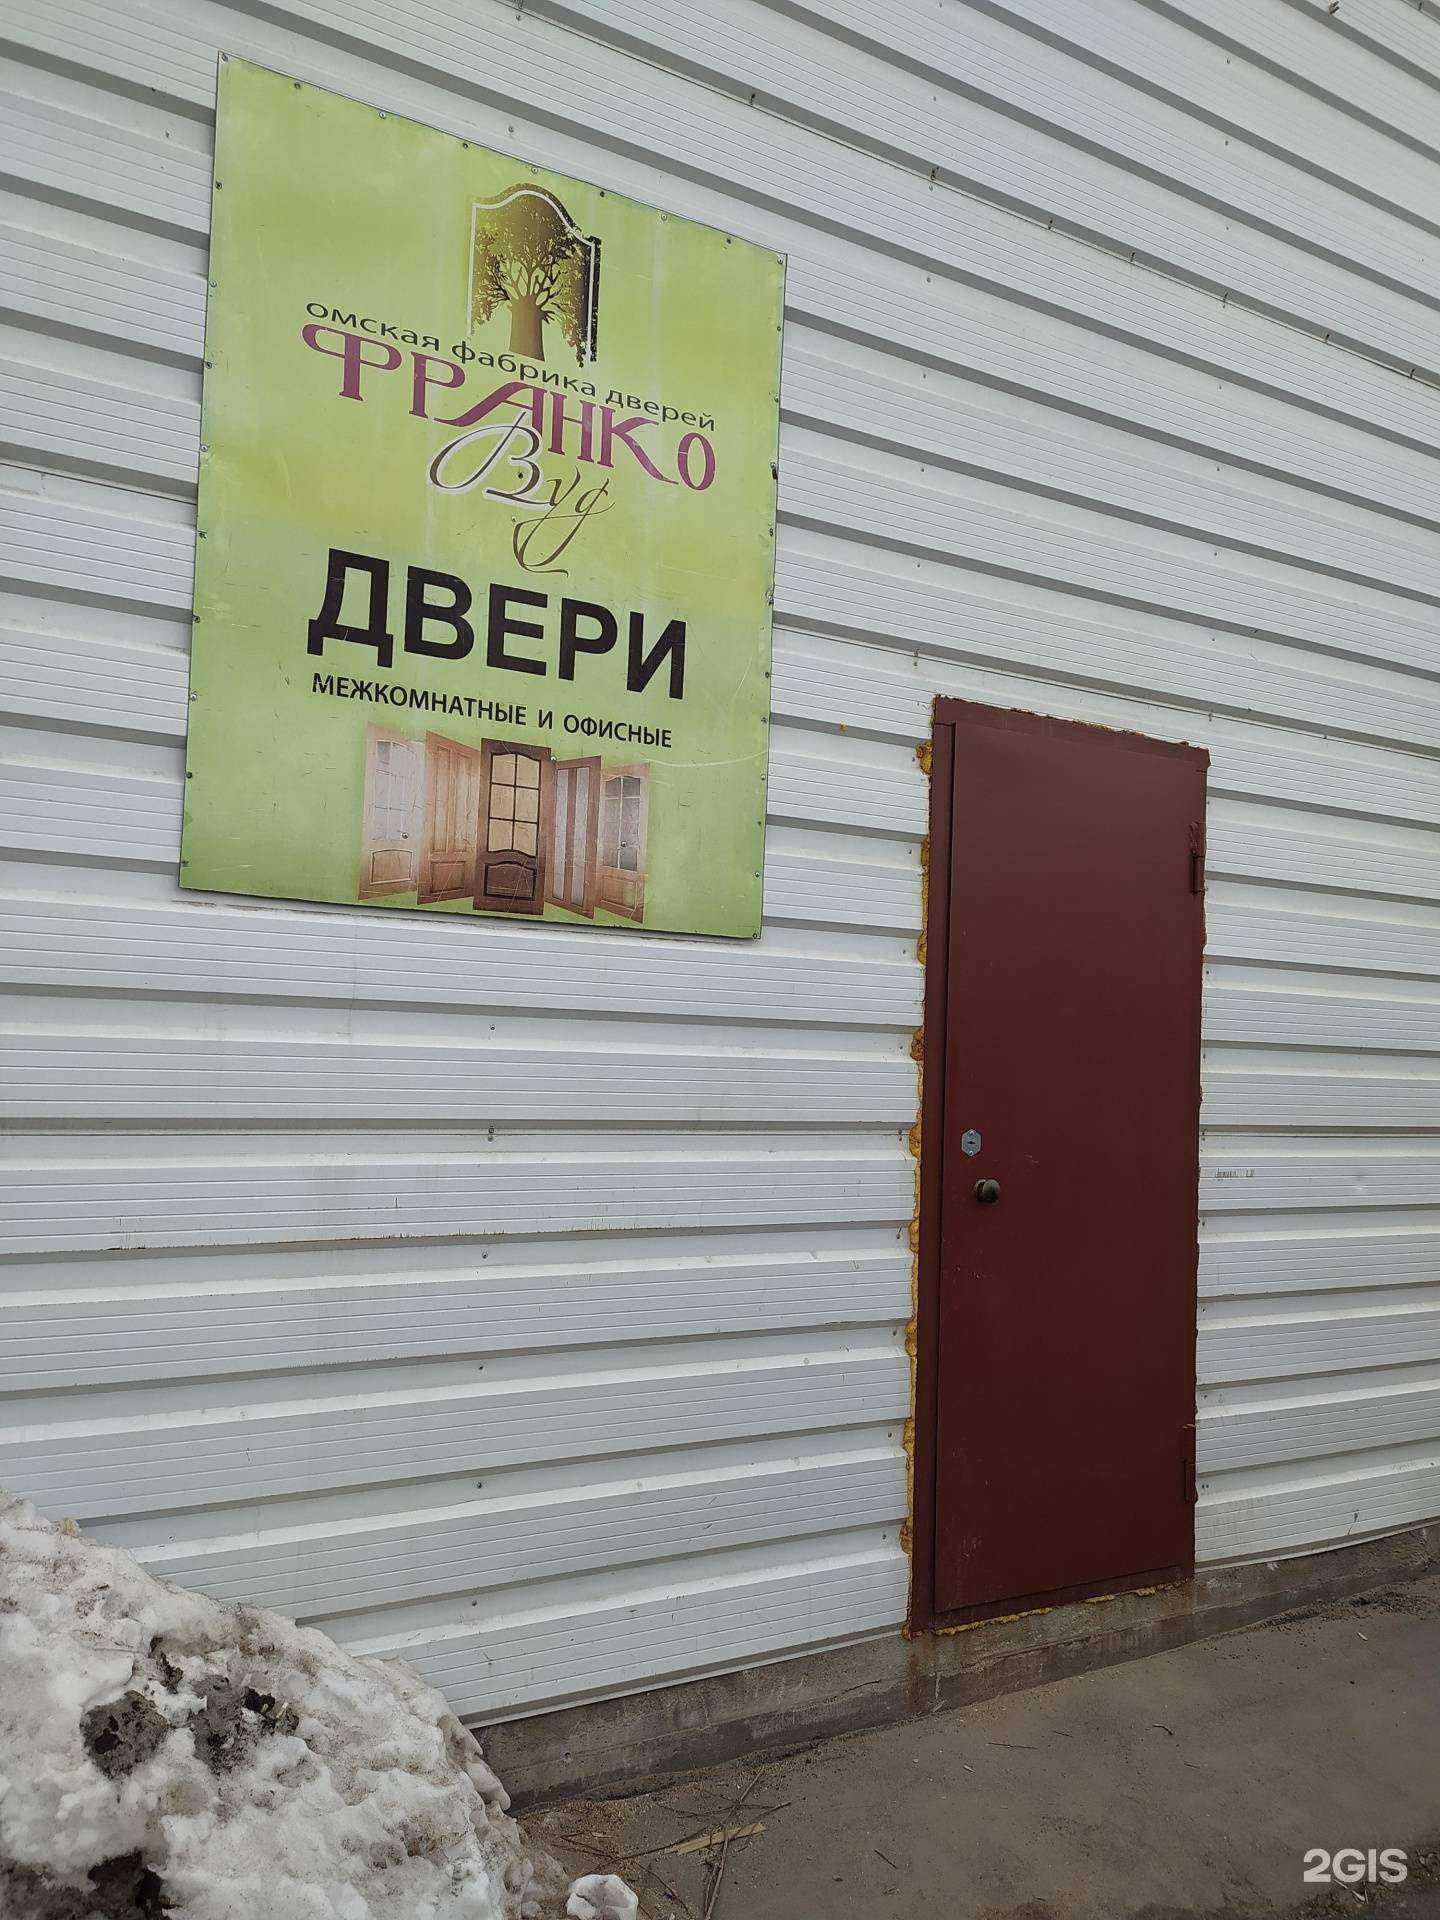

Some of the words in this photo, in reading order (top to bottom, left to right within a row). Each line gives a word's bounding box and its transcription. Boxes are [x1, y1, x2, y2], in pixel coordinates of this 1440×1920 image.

[302, 323, 716, 491] ФРАНКО
[306, 302, 440, 351] омская
[451, 340, 597, 398] фабрика
[605, 388, 716, 433] дверей
[307, 548, 687, 700] ДВЕРИ
[312, 672, 527, 726] МЕЖКОМНАТНЫЕ
[538, 710, 553, 729] И
[563, 714, 672, 748] ОФИСНЫЕ
